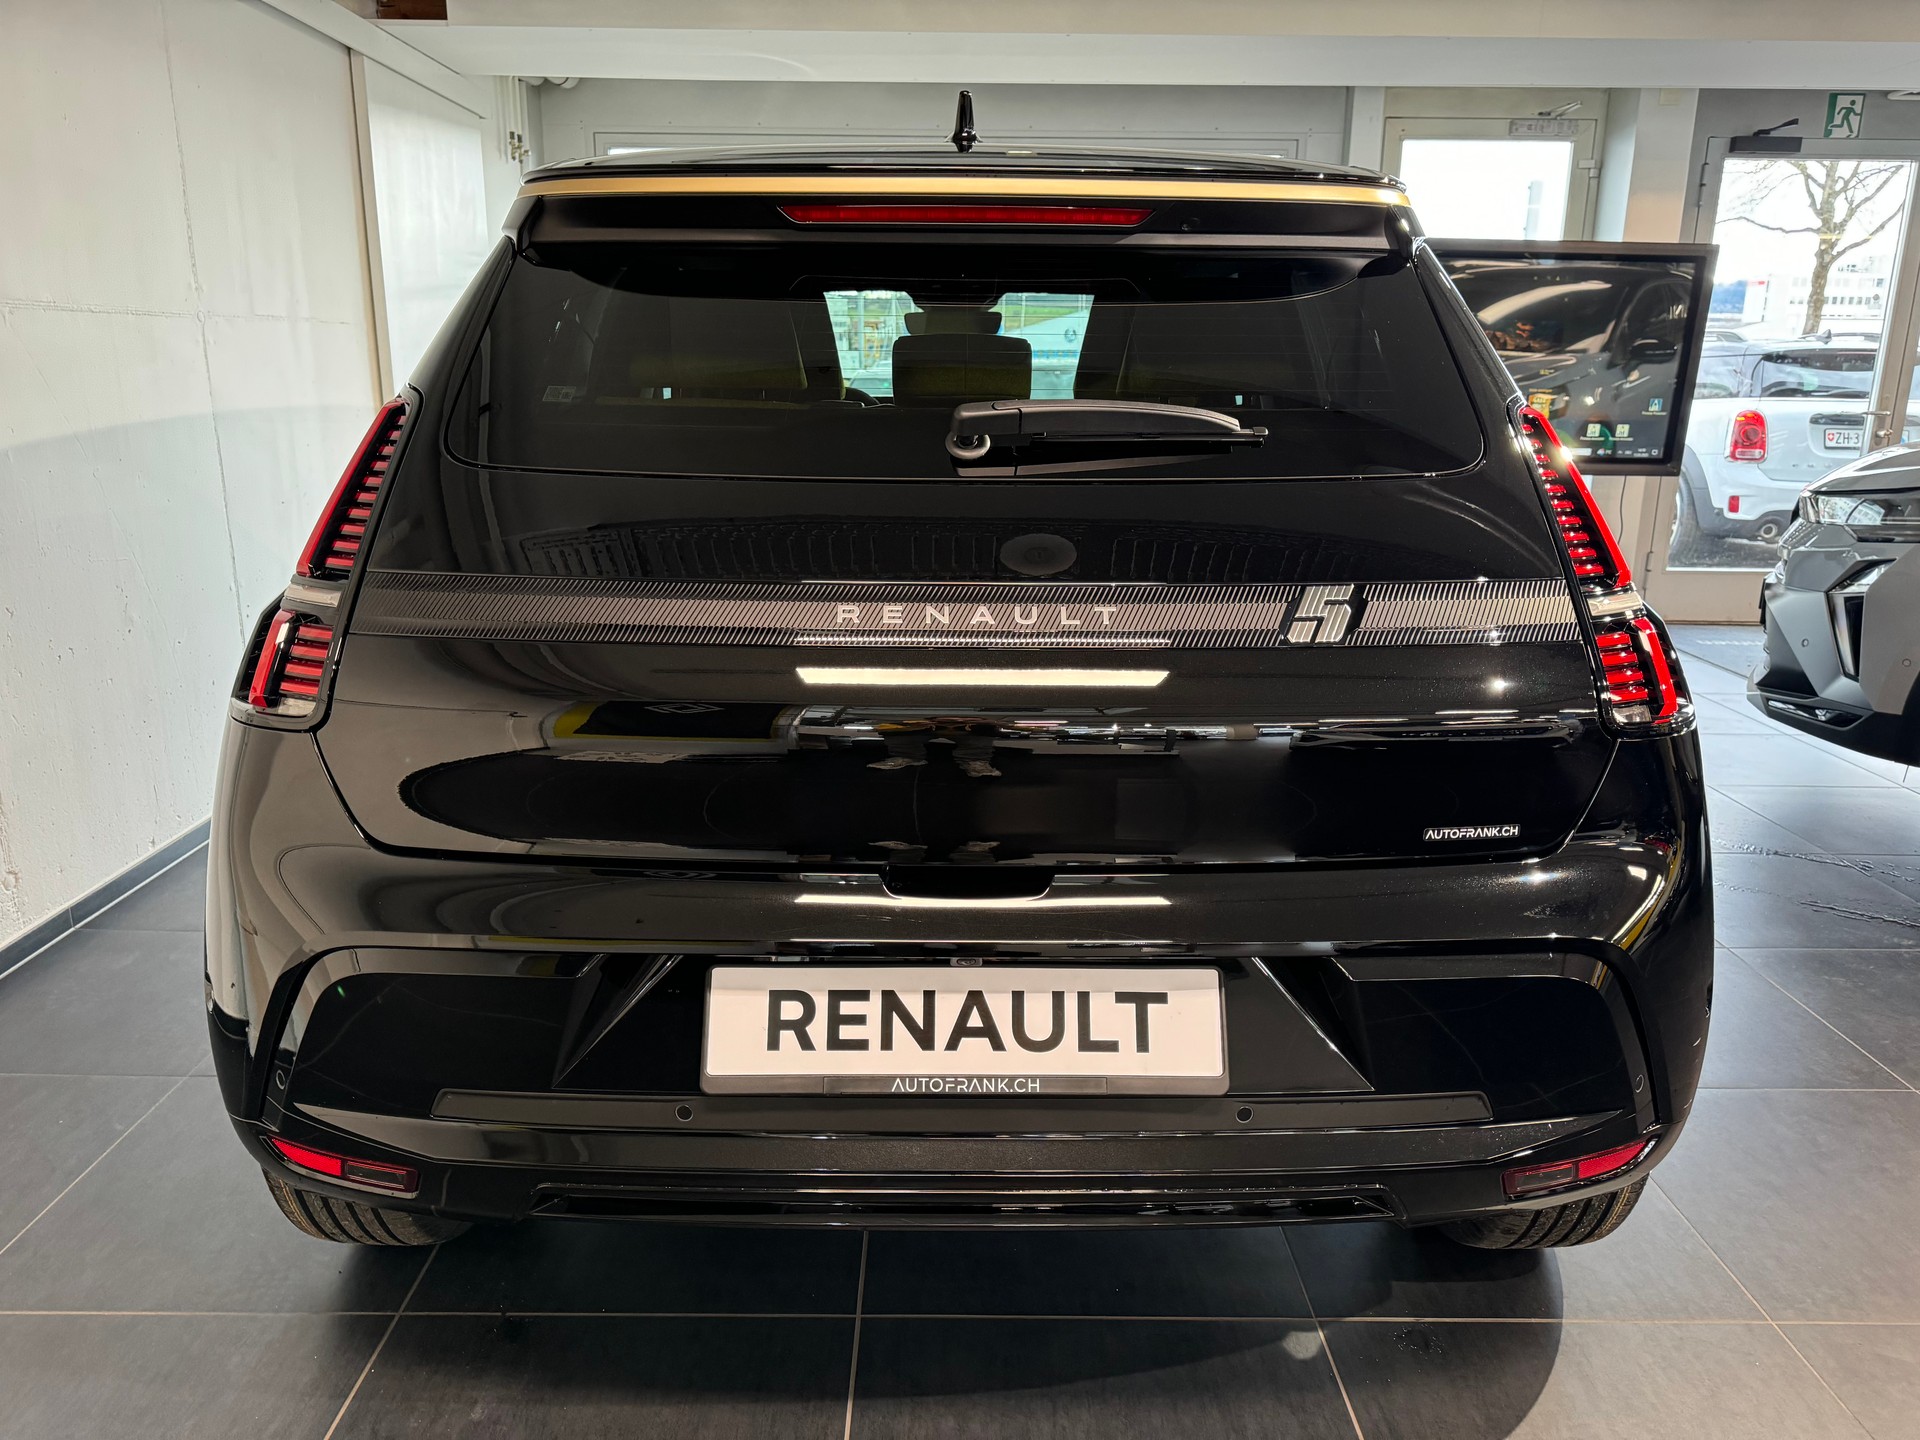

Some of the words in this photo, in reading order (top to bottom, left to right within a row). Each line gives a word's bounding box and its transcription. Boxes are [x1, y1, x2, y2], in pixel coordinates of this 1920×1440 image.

[836, 603, 1119, 626] RENAULT
[1286, 583, 1355, 644] 5
[1425, 825, 1519, 840] AUTOFRANK.CH
[765, 989, 1169, 1054] RENAULT
[891, 1077, 1041, 1093] AUTOFRANK.CH
